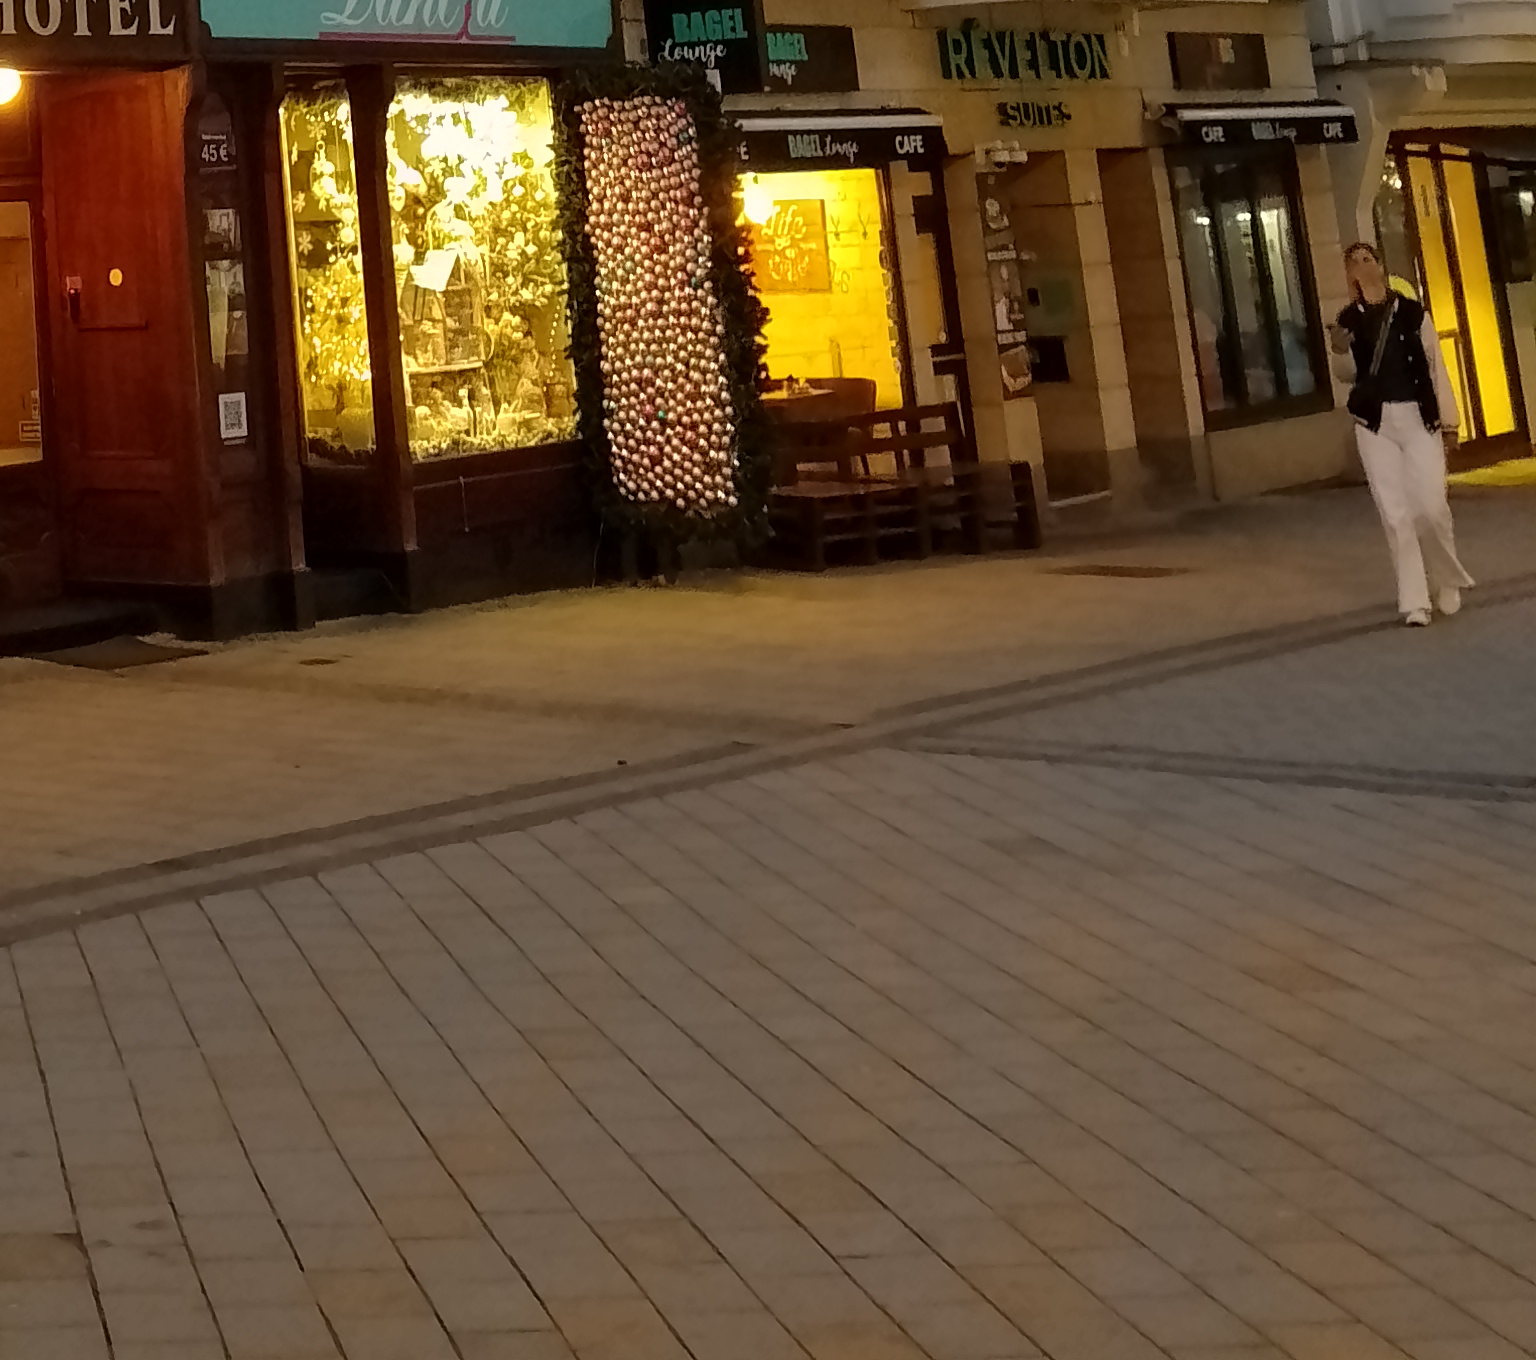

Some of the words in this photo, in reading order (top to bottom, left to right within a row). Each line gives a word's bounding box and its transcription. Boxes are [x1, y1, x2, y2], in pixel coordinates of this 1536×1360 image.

[672, 8, 749, 43] BAGEL
[658, 37, 728, 68] Lounge
[766, 32, 809, 61] BAGEL
[201, 144, 218, 162] 45
[220, 143, 229, 161] €
[788, 134, 824, 158] BAGEL
[895, 135, 925, 155] CAFE
